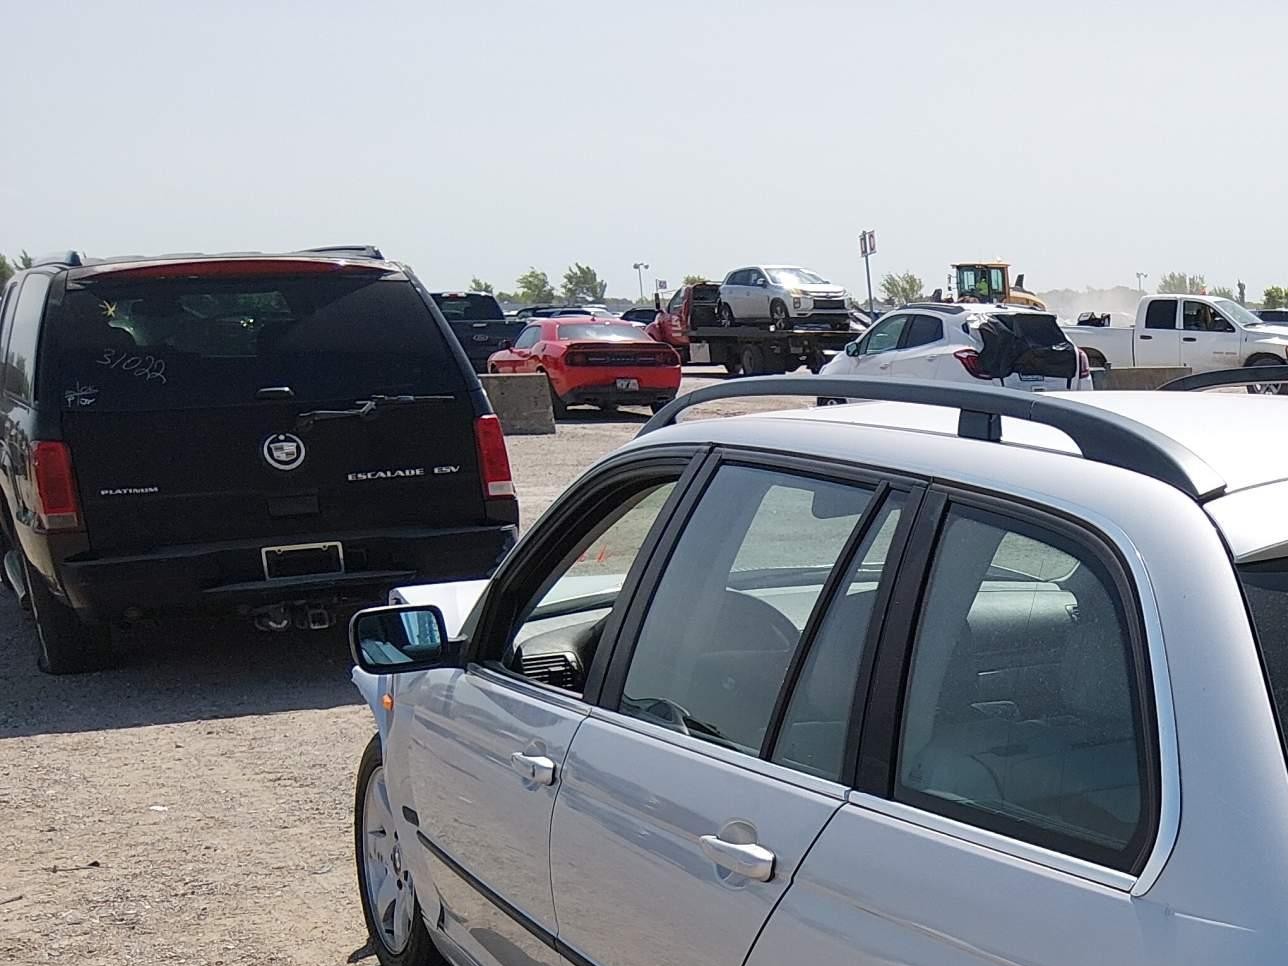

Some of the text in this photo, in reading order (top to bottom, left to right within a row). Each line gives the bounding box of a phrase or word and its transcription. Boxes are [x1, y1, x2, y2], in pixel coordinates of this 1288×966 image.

[96, 348, 167, 384] 31022
[347, 465, 460, 481] ESCALADE ESV
[101, 487, 158, 495] PLATINUM
